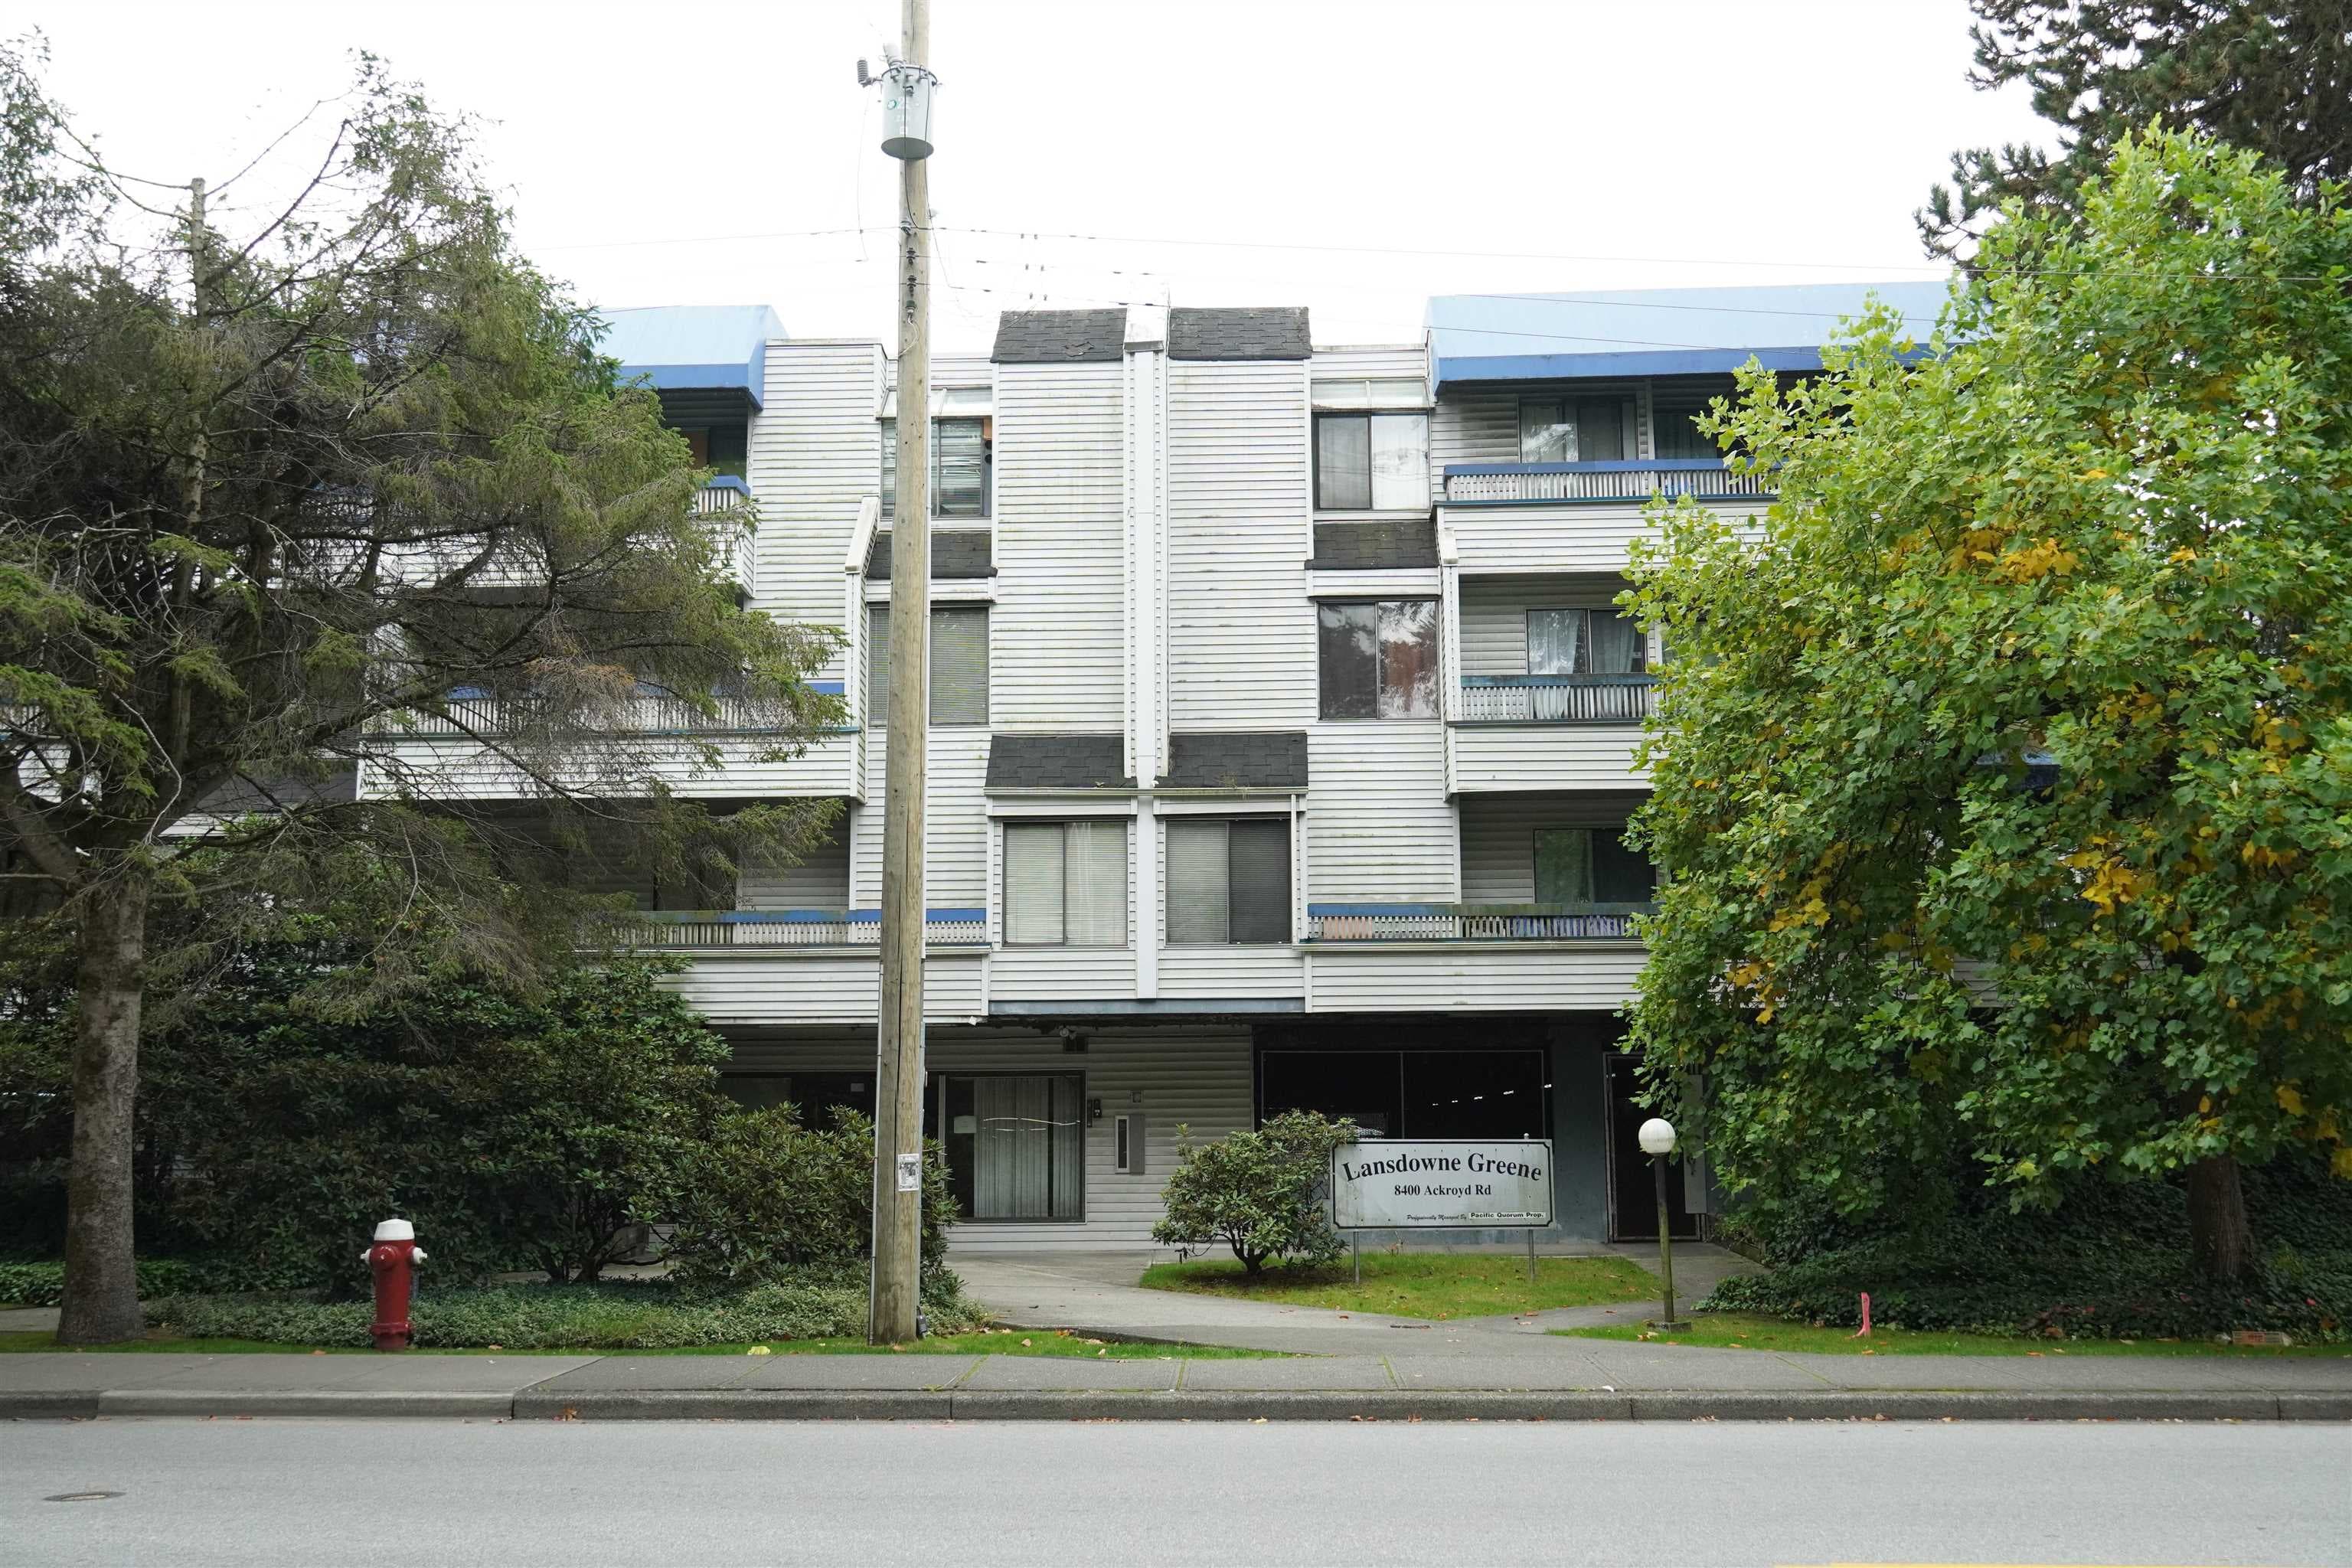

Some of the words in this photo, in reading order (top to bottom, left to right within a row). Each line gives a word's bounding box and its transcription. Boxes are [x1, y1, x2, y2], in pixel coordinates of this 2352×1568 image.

[1341, 1153, 1461, 1181] Lansdowne
[1468, 1153, 1541, 1181] Greene
[1394, 1184, 1420, 1196] 8400
[1424, 1184, 1471, 1197] Ackroyd
[1475, 1184, 1491, 1195] Rd
